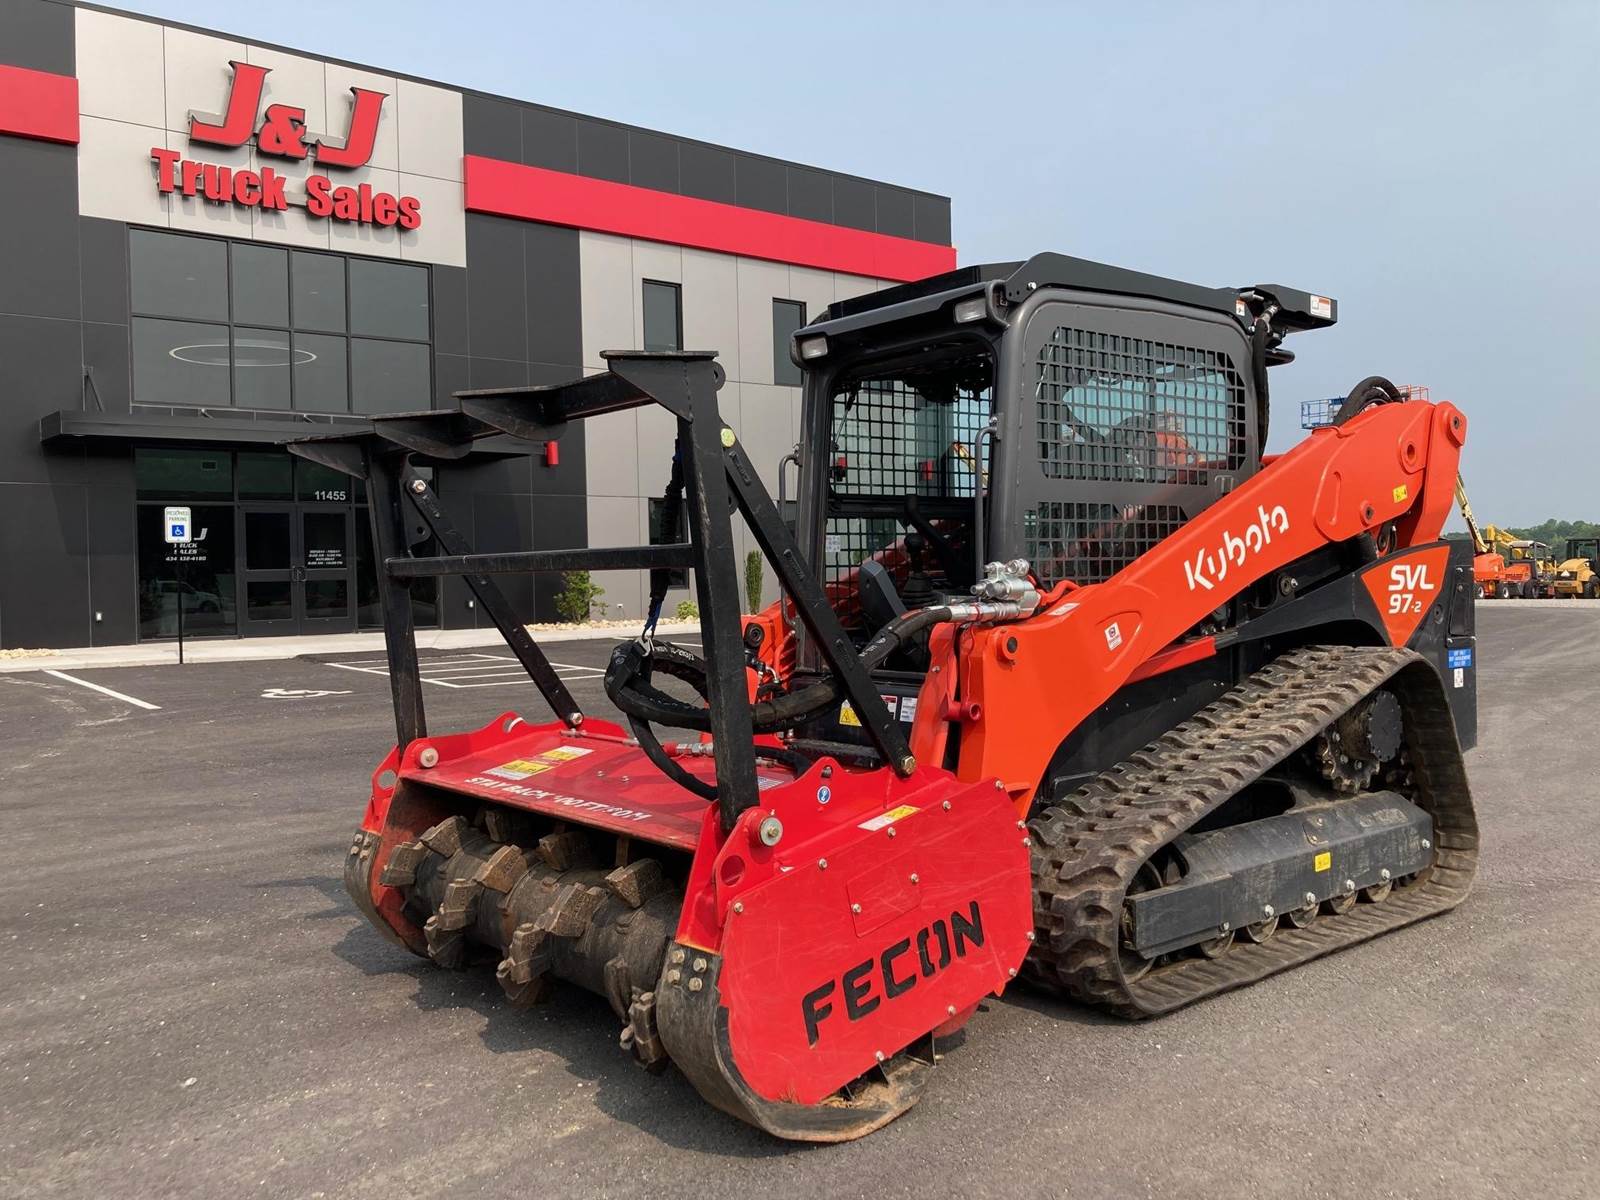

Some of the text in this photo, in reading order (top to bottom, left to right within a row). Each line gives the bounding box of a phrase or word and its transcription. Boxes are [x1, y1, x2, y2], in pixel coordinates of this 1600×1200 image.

[190, 60, 391, 168] J&J
[151, 147, 421, 230] Truck Sales
[314, 490, 346, 501] 11455
[1183, 504, 1290, 591] Kubota
[1388, 564, 1435, 591] SVL
[1388, 593, 1422, 614] 97-2
[463, 777, 513, 789] STAY
[501, 785, 556, 799] BACK
[801, 900, 985, 1046] FECON
